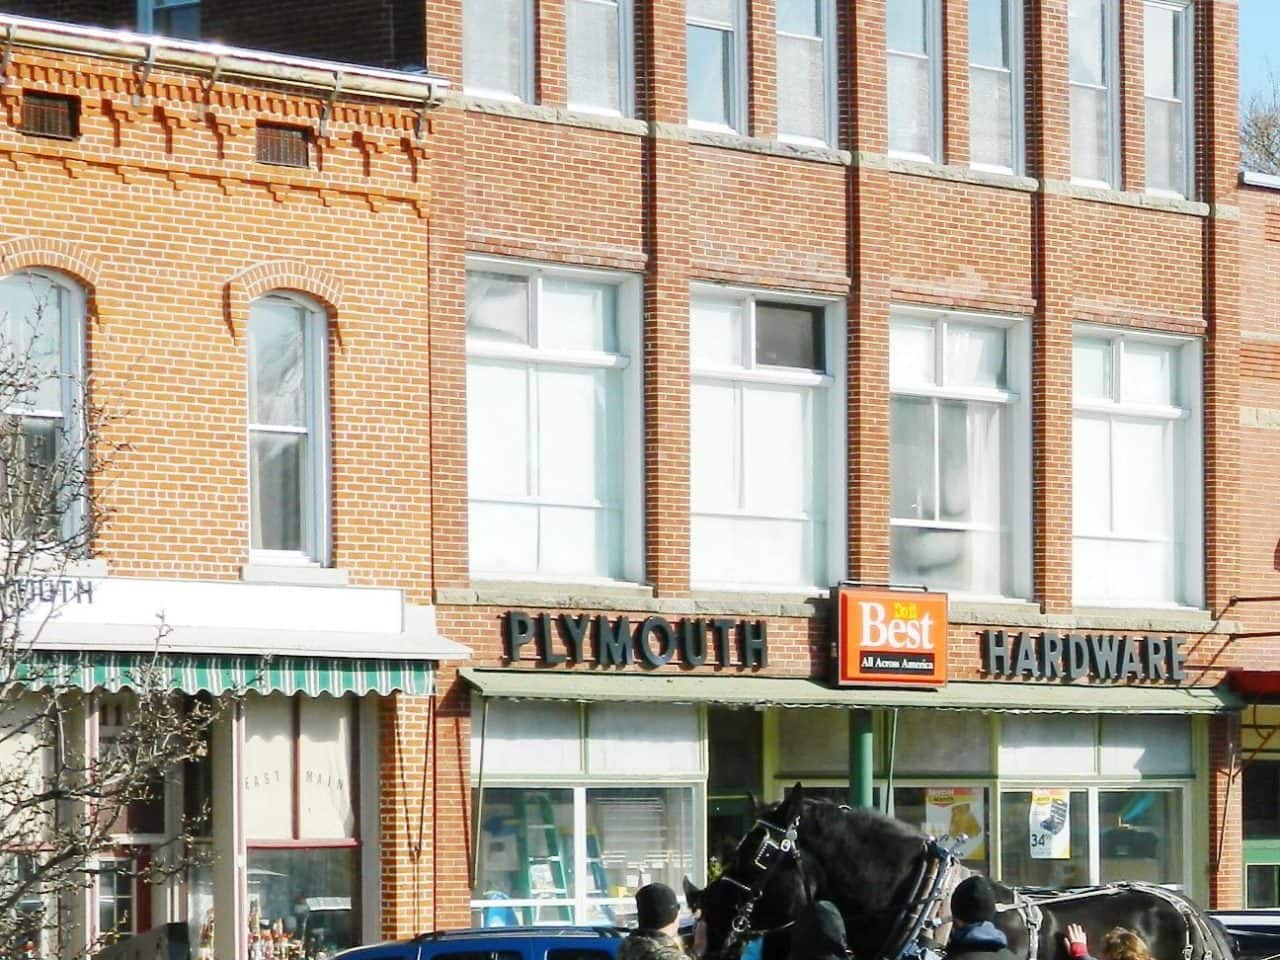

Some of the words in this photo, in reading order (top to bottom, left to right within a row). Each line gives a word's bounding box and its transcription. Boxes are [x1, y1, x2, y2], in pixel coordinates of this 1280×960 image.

[504, 610, 769, 668] PLYMOUTH
[858, 601, 934, 649] Best
[861, 657, 873, 668] All
[875, 658, 900, 668] Across
[902, 659, 934, 670] America
[983, 630, 1187, 680] HARDWARE
[244, 770, 279, 790] EAST
[306, 770, 343, 790] MAIN
